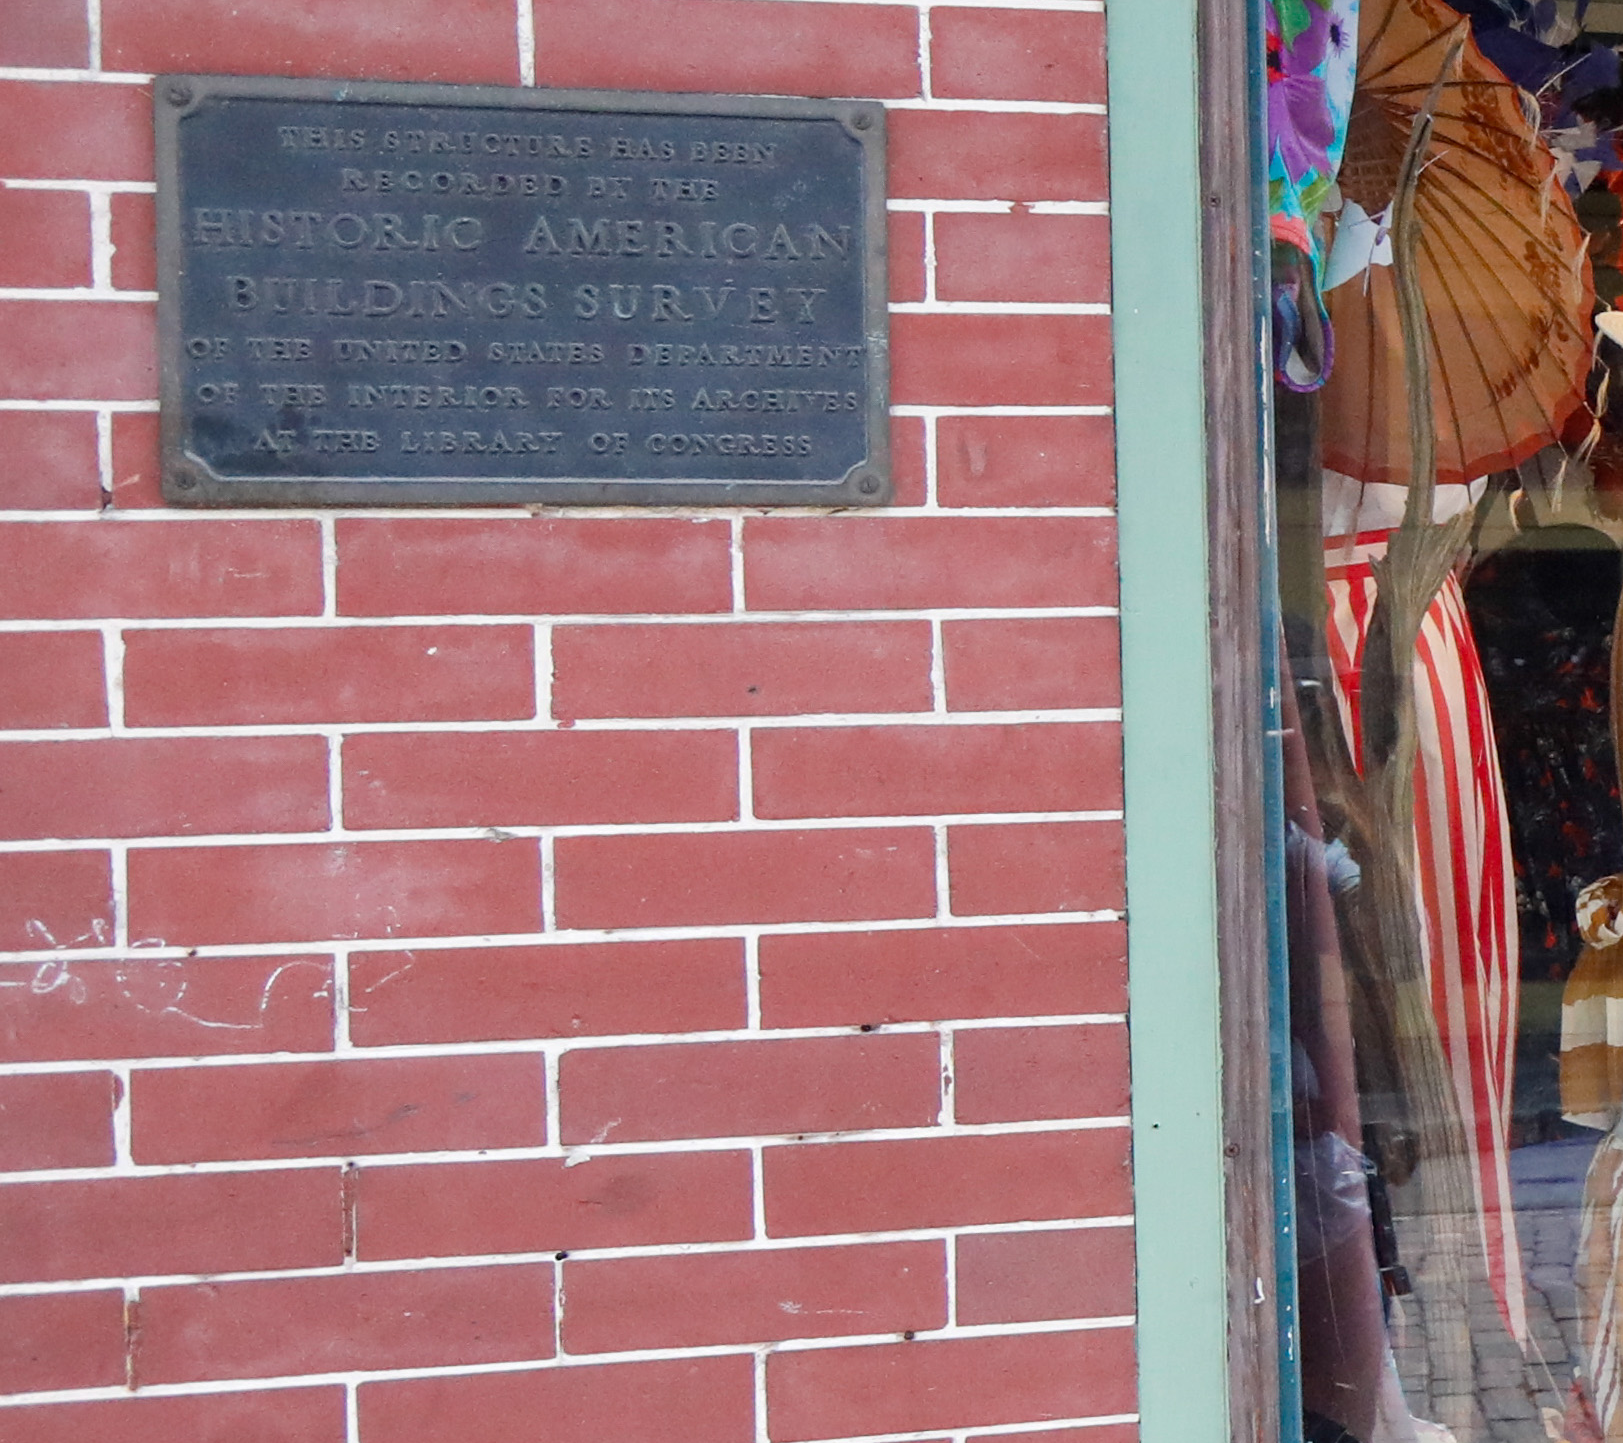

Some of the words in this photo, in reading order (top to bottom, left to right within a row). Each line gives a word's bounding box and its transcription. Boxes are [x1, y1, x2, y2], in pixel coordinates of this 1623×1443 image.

[277, 125, 366, 151] THIS
[383, 129, 597, 159] STRUCTURE
[609, 135, 676, 161] HAS
[689, 140, 779, 165] BEEN
[340, 167, 568, 198] RECORDED
[586, 175, 633, 199] BY
[650, 177, 720, 202] THE
[194, 207, 484, 252] HISTORIC
[523, 214, 851, 261] AMERICAN
[226, 274, 548, 320] BUILDINGS
[574, 283, 827, 325] SURVEY
[187, 337, 230, 359] OF
[247, 337, 313, 362] THE
[331, 339, 469, 364] UNITED
[487, 341, 605, 365] STATES
[626, 343, 864, 368] DEPARTMENT
[198, 382, 240, 405] OF
[258, 383, 328, 407] THE
[346, 383, 531, 409] INTERIOR
[547, 386, 614, 410] FOR
[628, 387, 676, 411] ITS
[691, 386, 859, 412] ARCHIVES
[253, 428, 298, 454] AT
[310, 428, 382, 454] THE
[400, 429, 564, 456] LIBRARY
[588, 431, 630, 456] OF
[647, 432, 814, 459] CONGRESS
